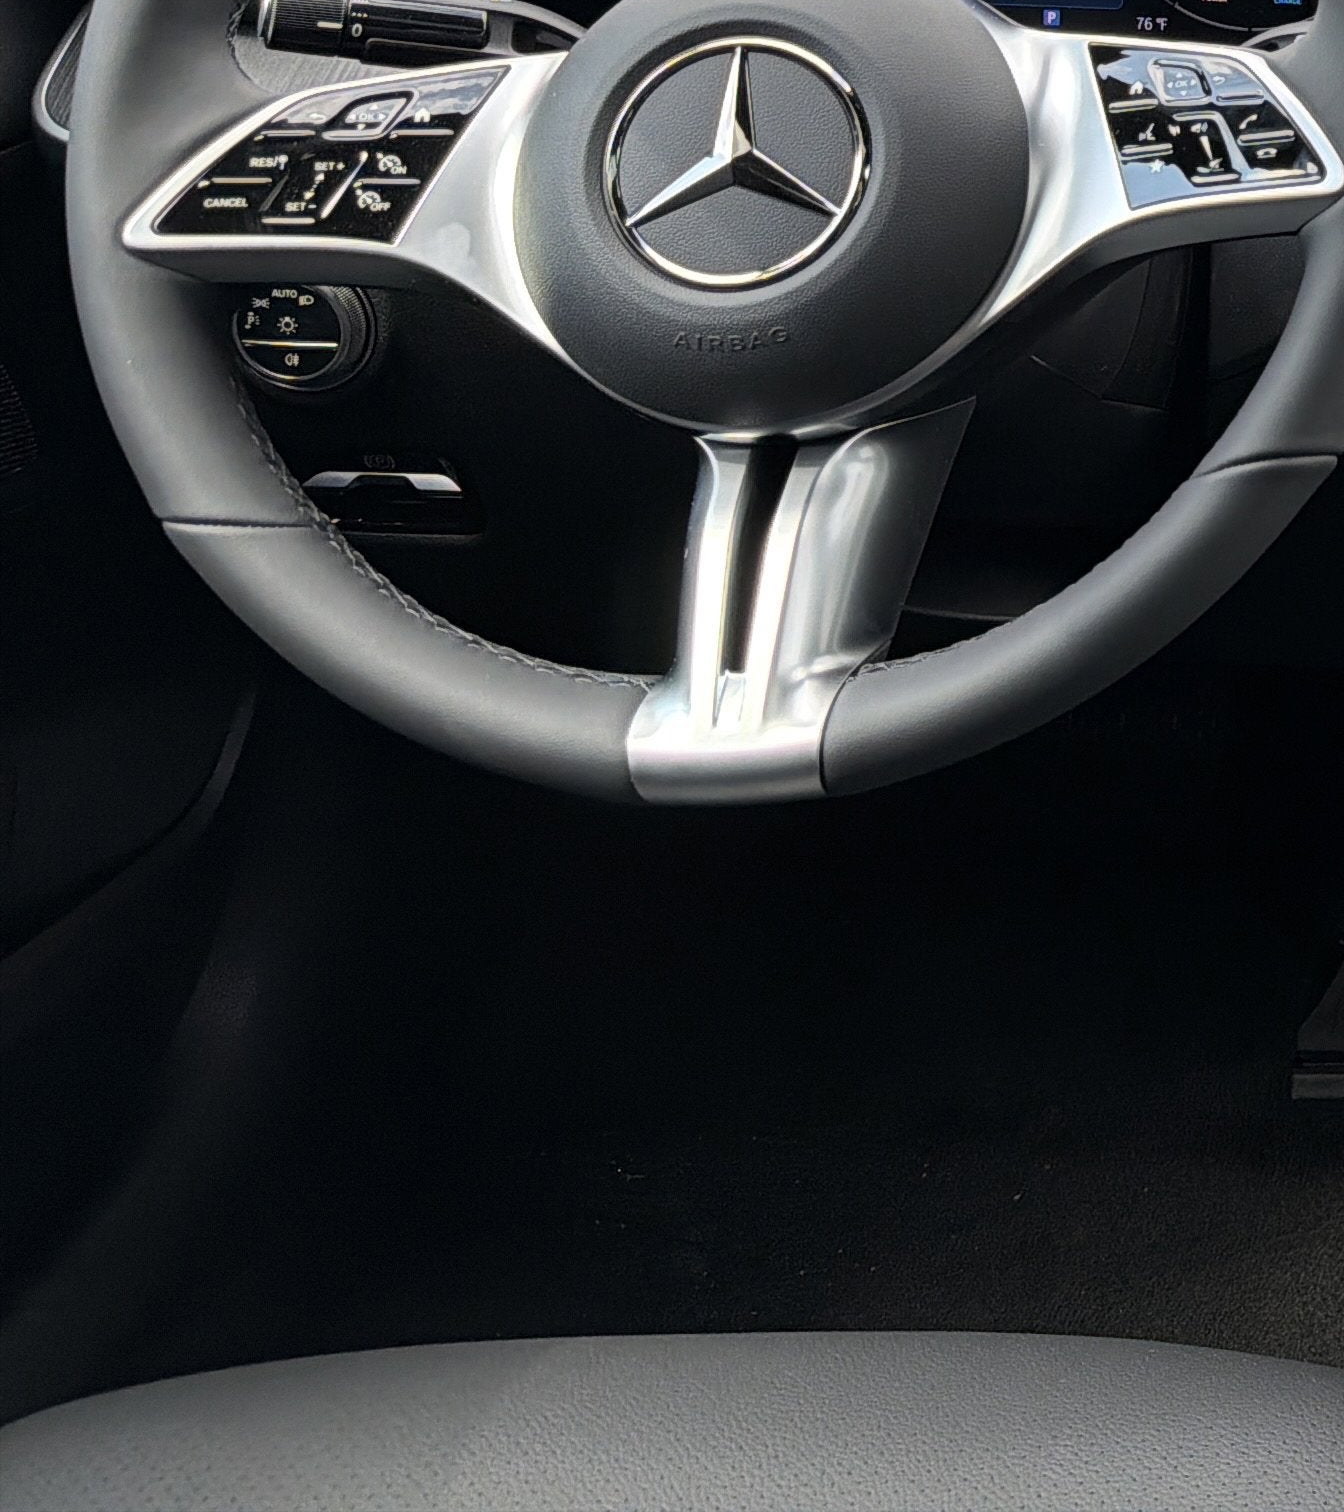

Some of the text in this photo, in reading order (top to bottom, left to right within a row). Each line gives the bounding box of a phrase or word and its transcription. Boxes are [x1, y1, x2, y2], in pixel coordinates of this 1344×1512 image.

[1136, 17, 1153, 30] 76
[389, 164, 408, 175] ON
[203, 197, 249, 208] CANCEL
[284, 201, 307, 212] SET
[369, 202, 391, 212] OFF
[271, 289, 298, 299] AUTO
[672, 326, 788, 352] AIRBAG
